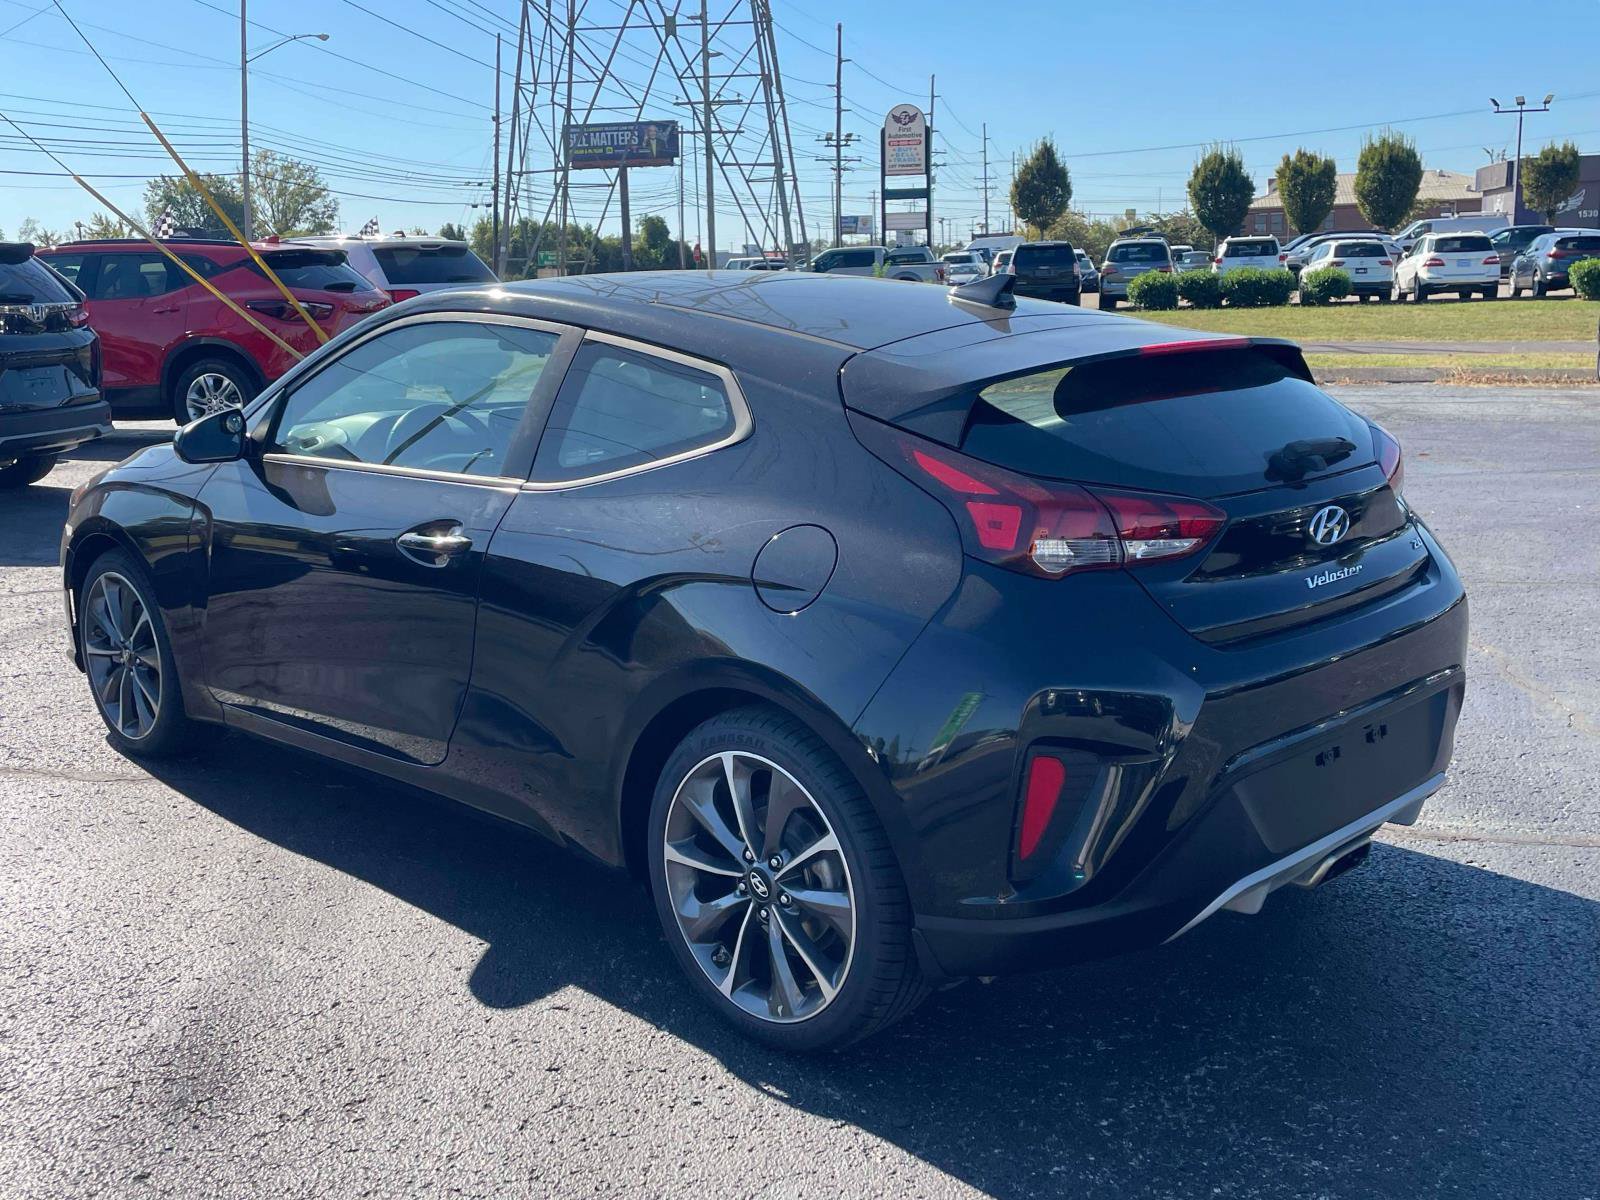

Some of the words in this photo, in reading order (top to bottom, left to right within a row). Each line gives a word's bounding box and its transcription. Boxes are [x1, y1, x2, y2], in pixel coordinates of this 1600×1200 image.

[590, 130, 639, 146] MATTERS
[1577, 209, 1599, 218] 1530
[1305, 564, 1363, 589] Veloster
